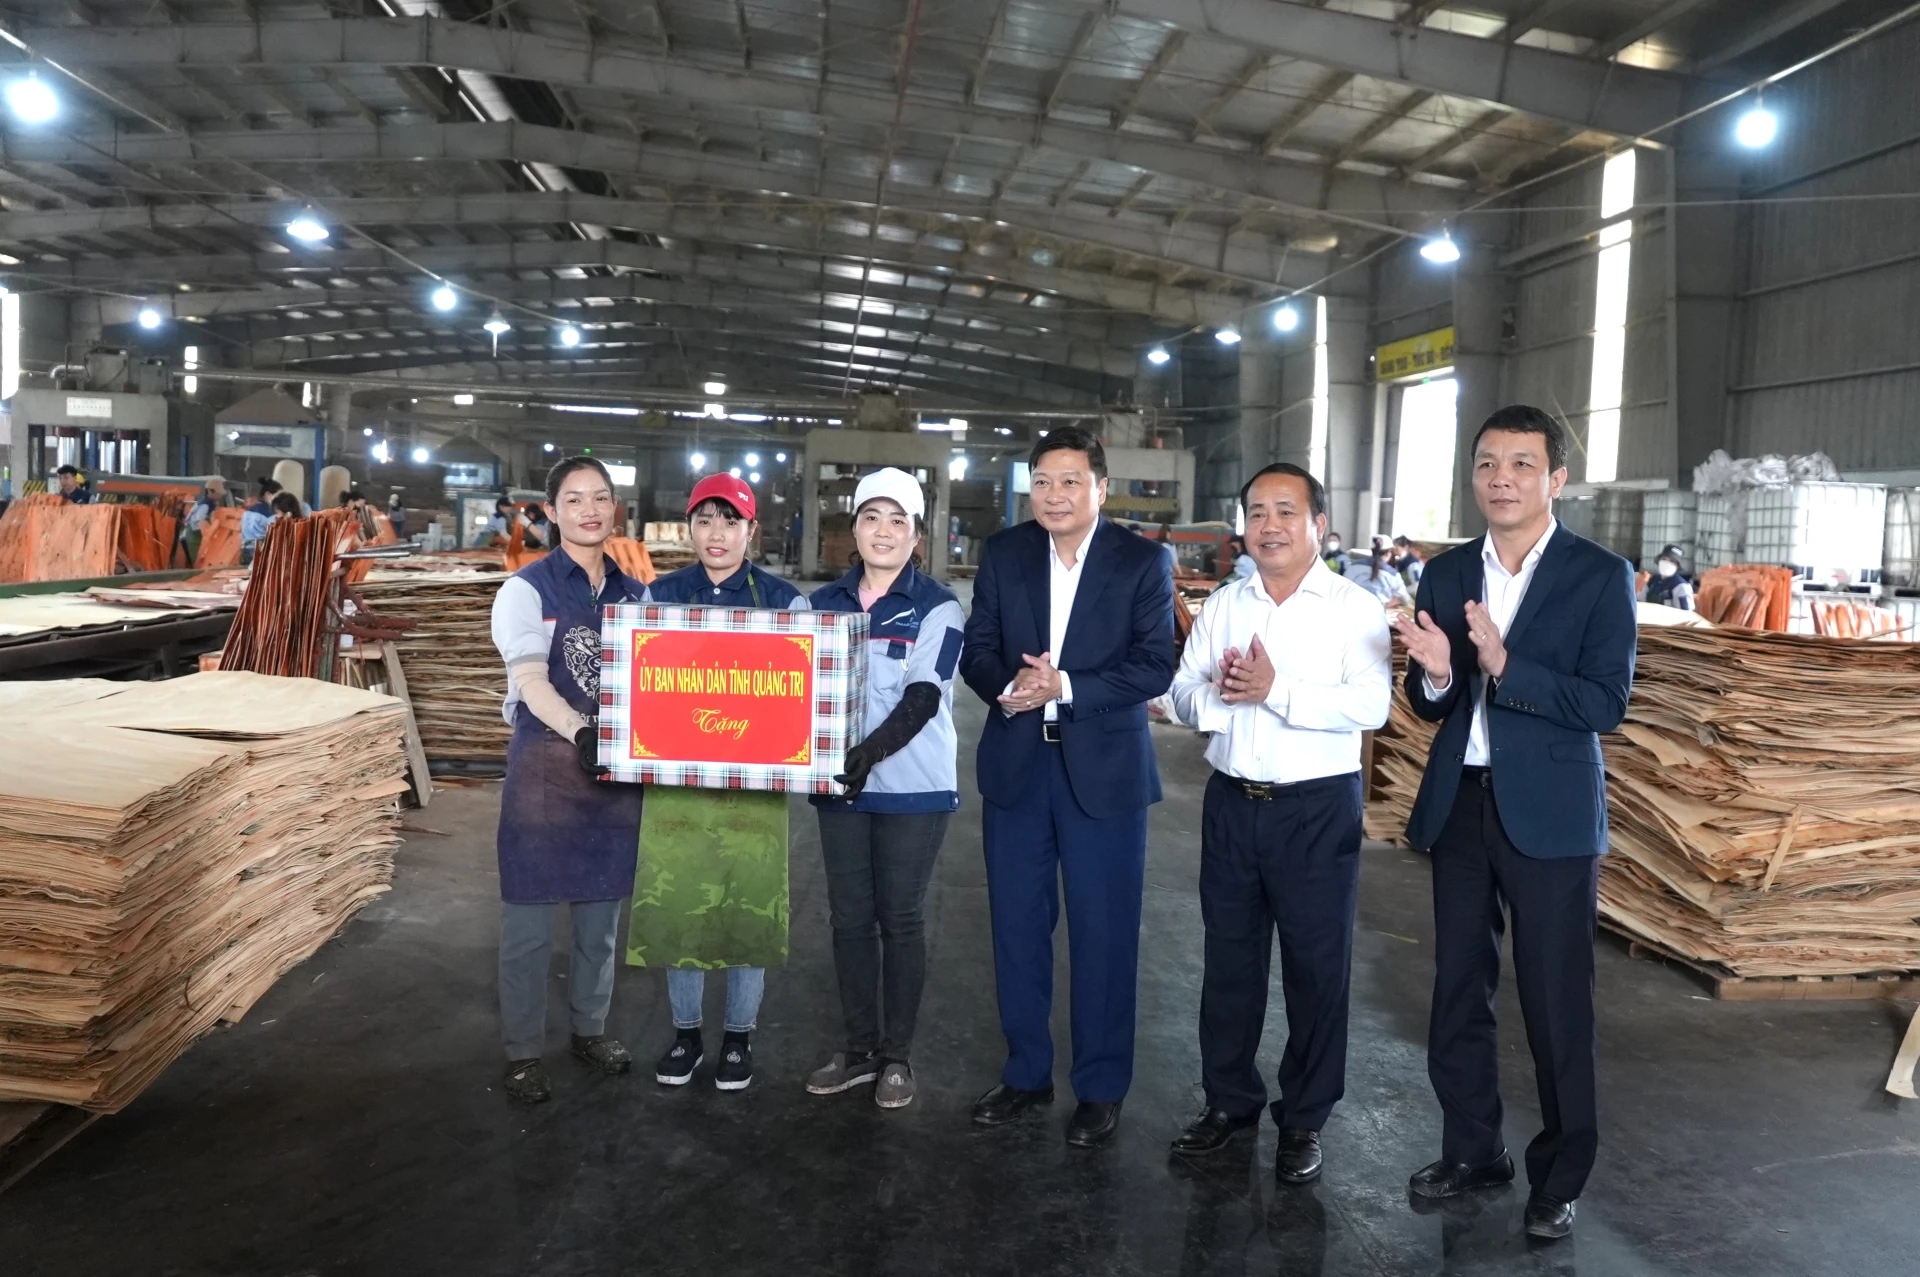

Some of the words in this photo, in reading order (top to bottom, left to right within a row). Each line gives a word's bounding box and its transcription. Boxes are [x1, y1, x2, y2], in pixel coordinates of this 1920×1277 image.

[640, 657, 653, 692] ỦY
[654, 666, 675, 693] BAN
[676, 660, 704, 694] NHÂN
[706, 661, 727, 695] DÂN
[728, 660, 751, 696] TỈNH
[752, 661, 787, 699] QUẢNG
[789, 670, 805, 704] TRỊ
[691, 707, 750, 740] Tặng
